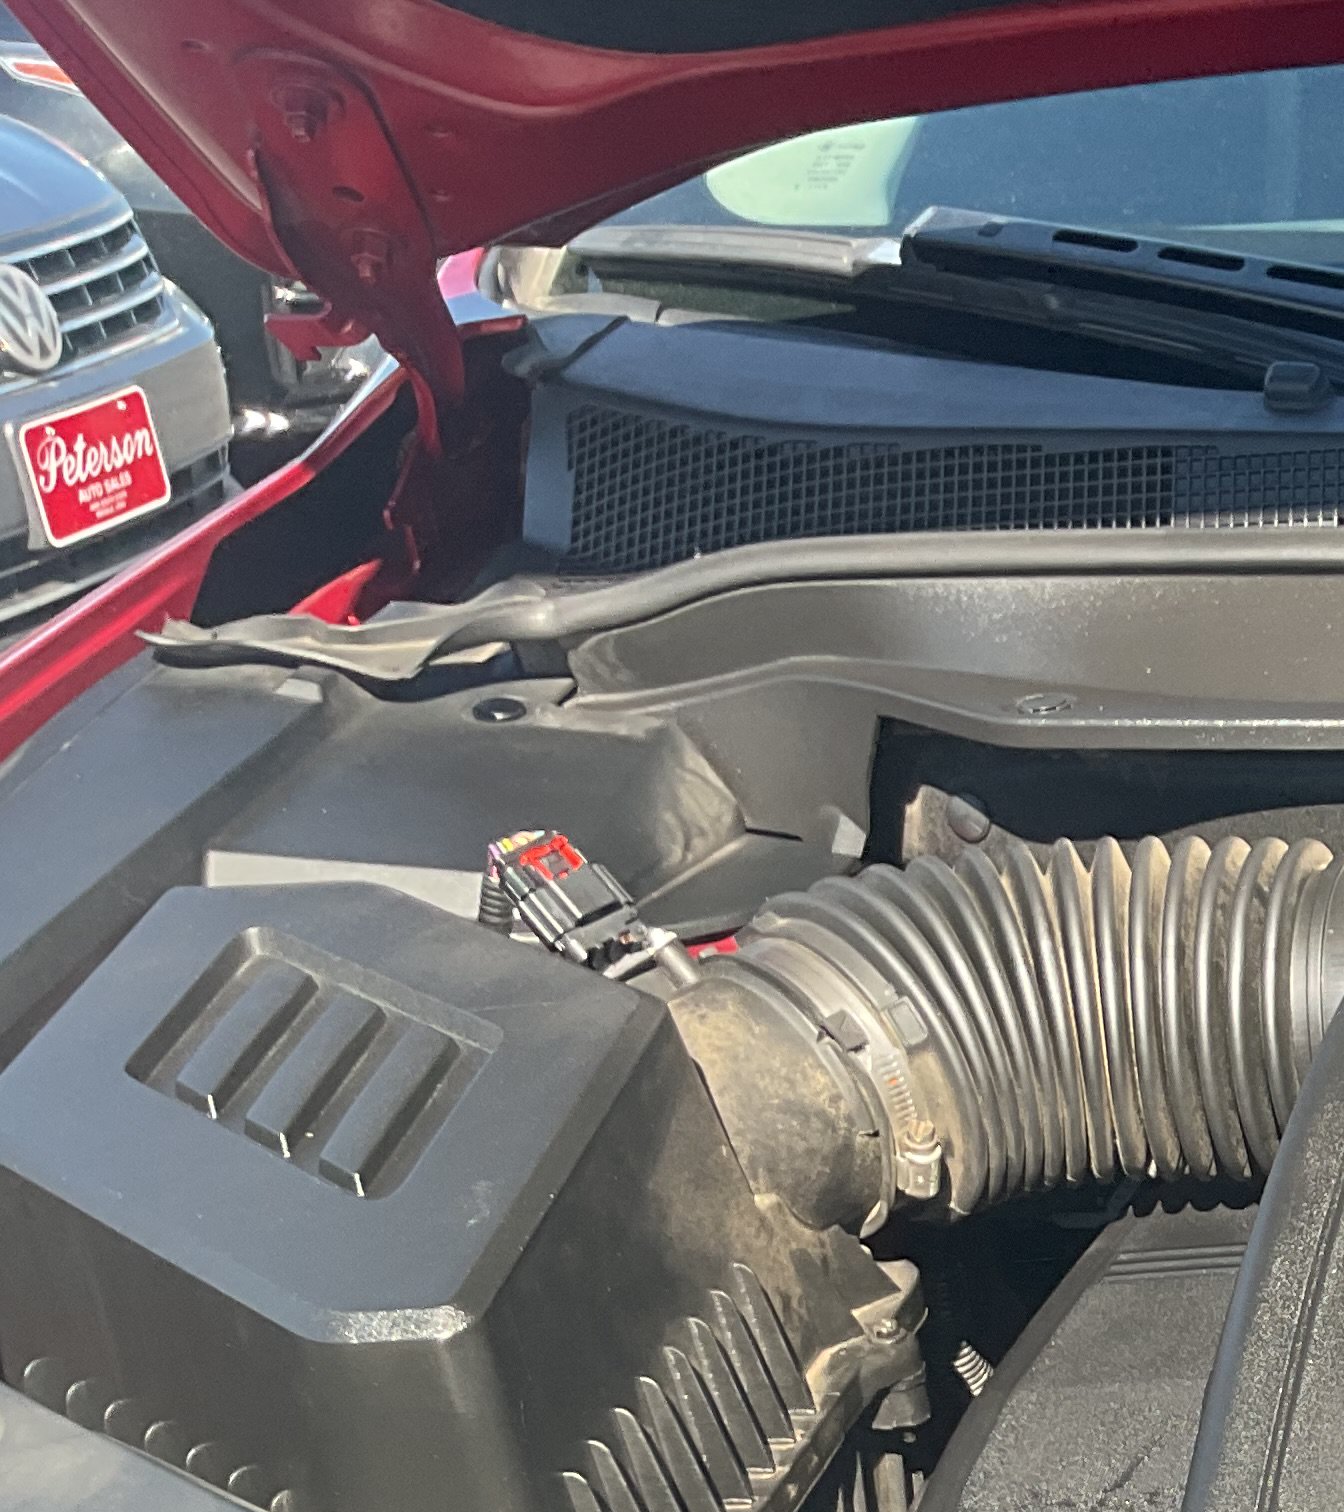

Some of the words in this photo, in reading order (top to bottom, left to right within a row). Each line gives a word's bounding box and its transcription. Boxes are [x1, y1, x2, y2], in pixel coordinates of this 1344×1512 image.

[37, 427, 154, 494] Peterson
[78, 481, 104, 504] AUTO
[104, 470, 132, 494] SALES
